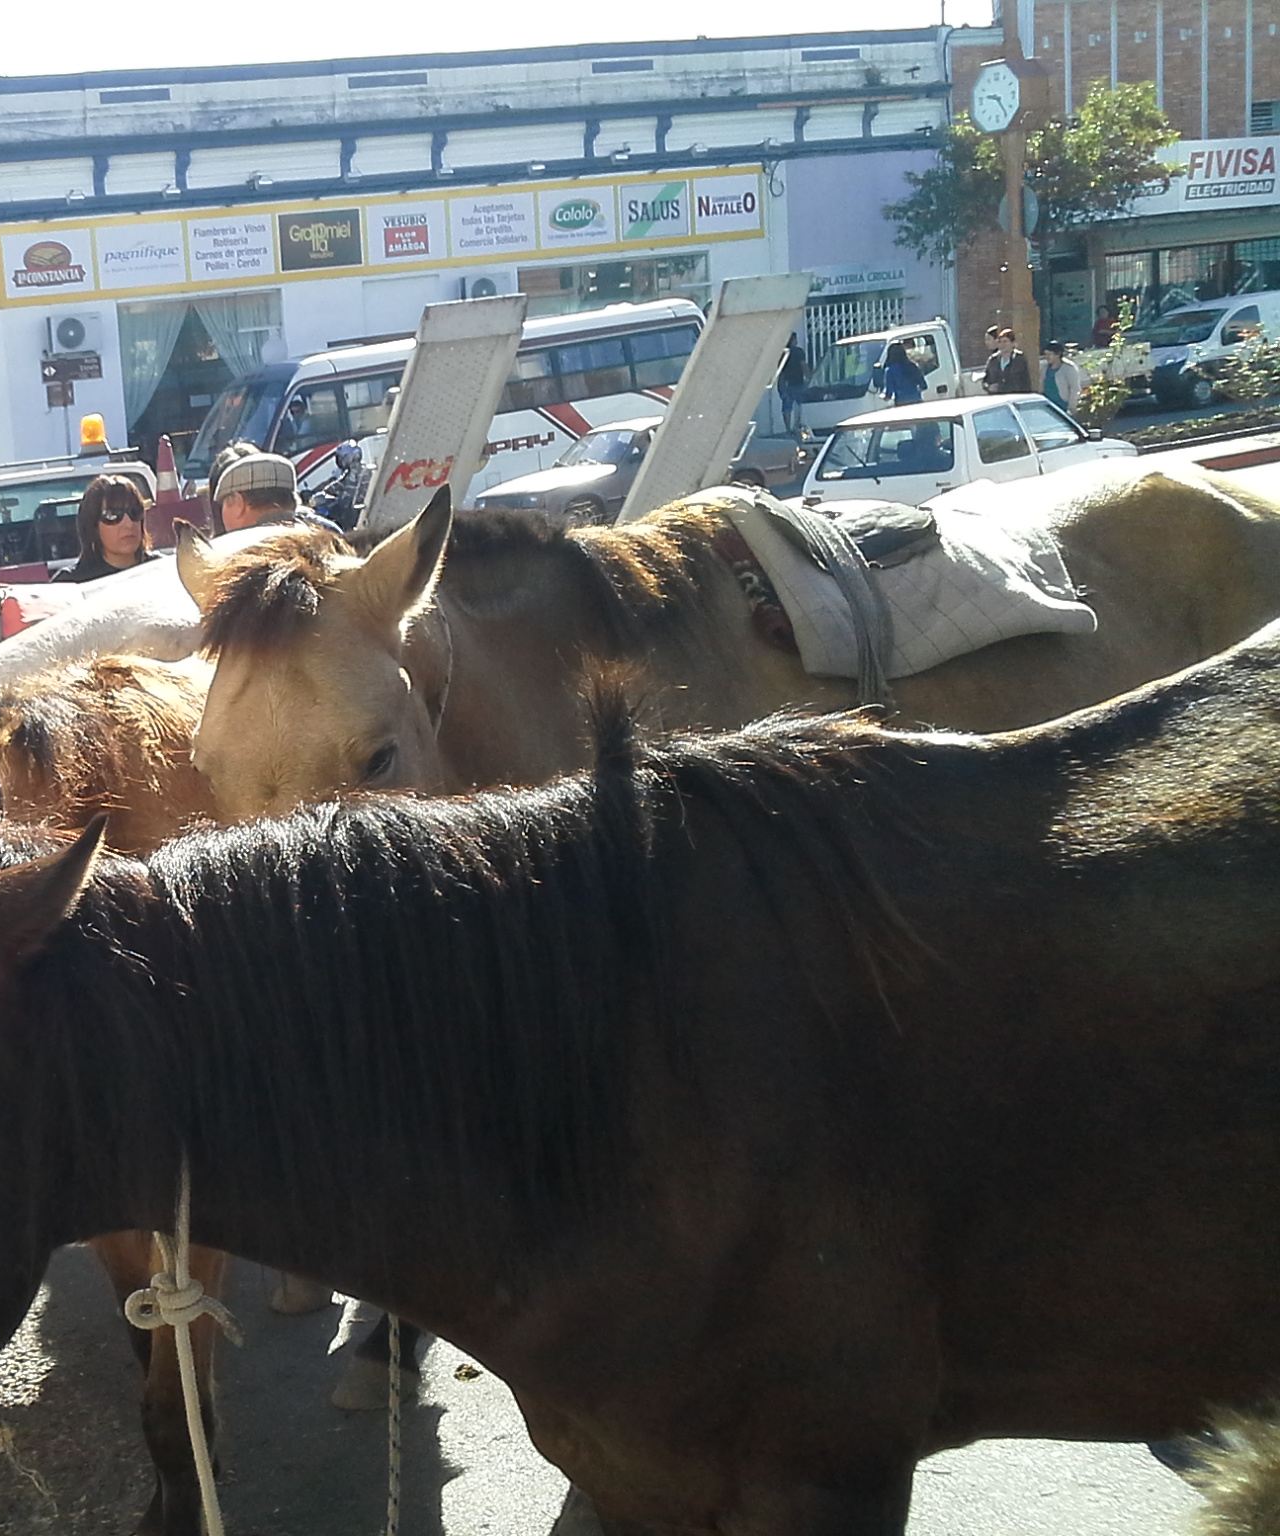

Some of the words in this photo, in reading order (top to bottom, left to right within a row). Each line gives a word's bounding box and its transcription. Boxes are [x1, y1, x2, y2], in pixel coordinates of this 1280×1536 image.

[1187, 146, 1275, 180] FIVISA
[1188, 180, 1272, 198] ELECTRICIDAD
[628, 199, 681, 223] SALUS
[697, 191, 756, 217] NATALEO
[459, 238, 494, 248] Comercio
[495, 234, 528, 245] Solidario
[195, 250, 223, 260] Carnes
